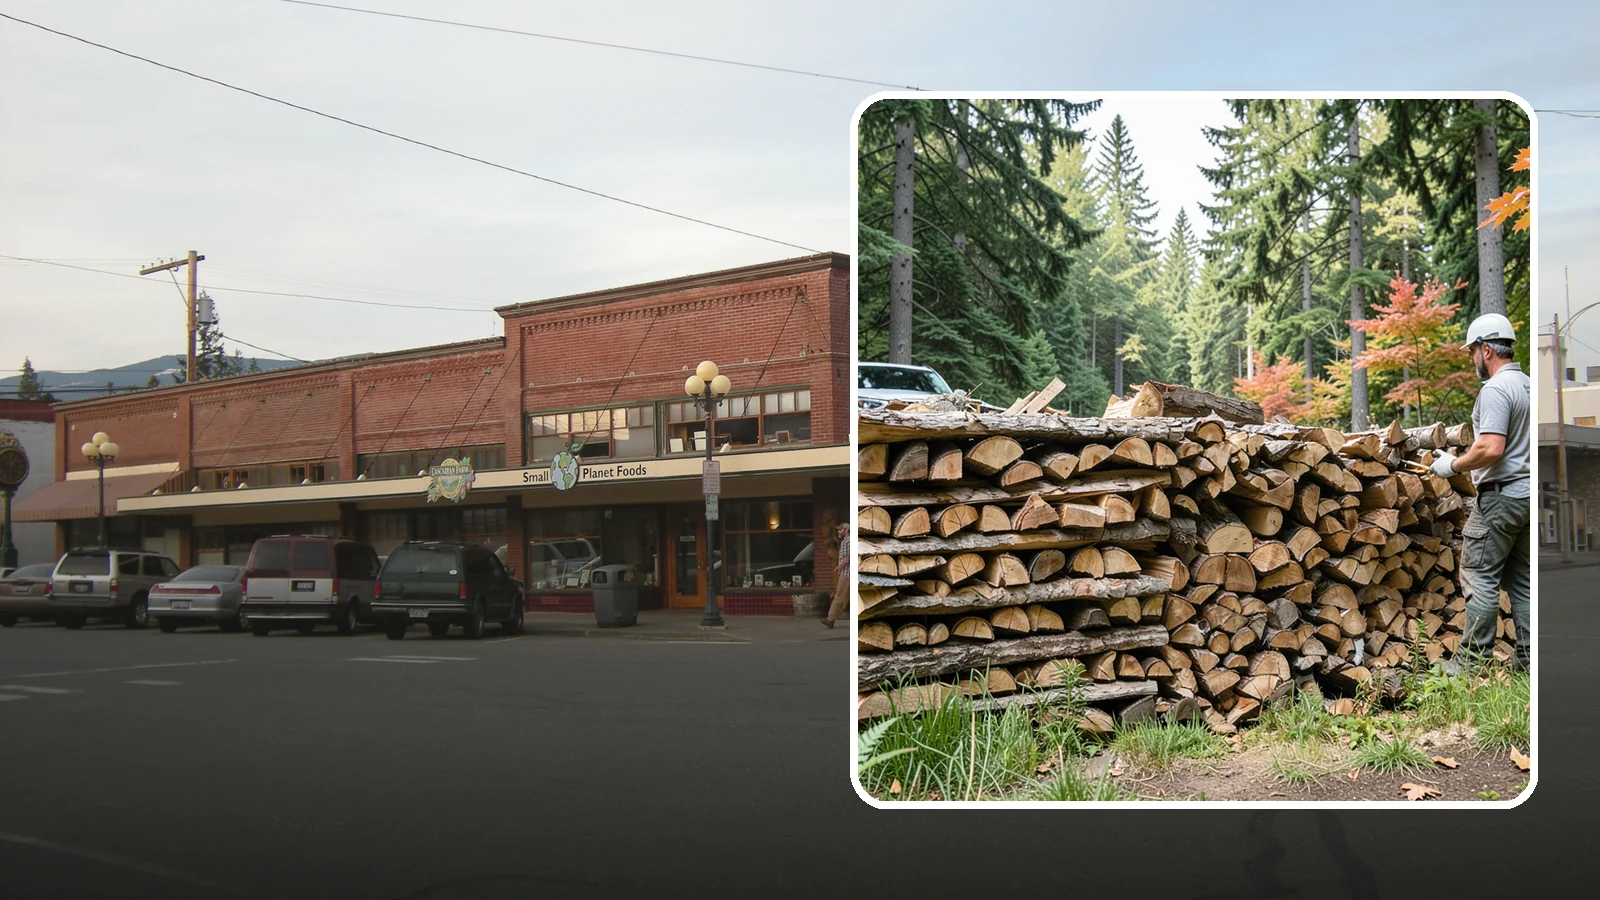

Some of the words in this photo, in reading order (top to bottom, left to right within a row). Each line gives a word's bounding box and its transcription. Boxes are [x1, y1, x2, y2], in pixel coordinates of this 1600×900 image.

[523, 470, 549, 483] Small
[583, 467, 614, 479] Planet
[617, 464, 647, 477] Foods
